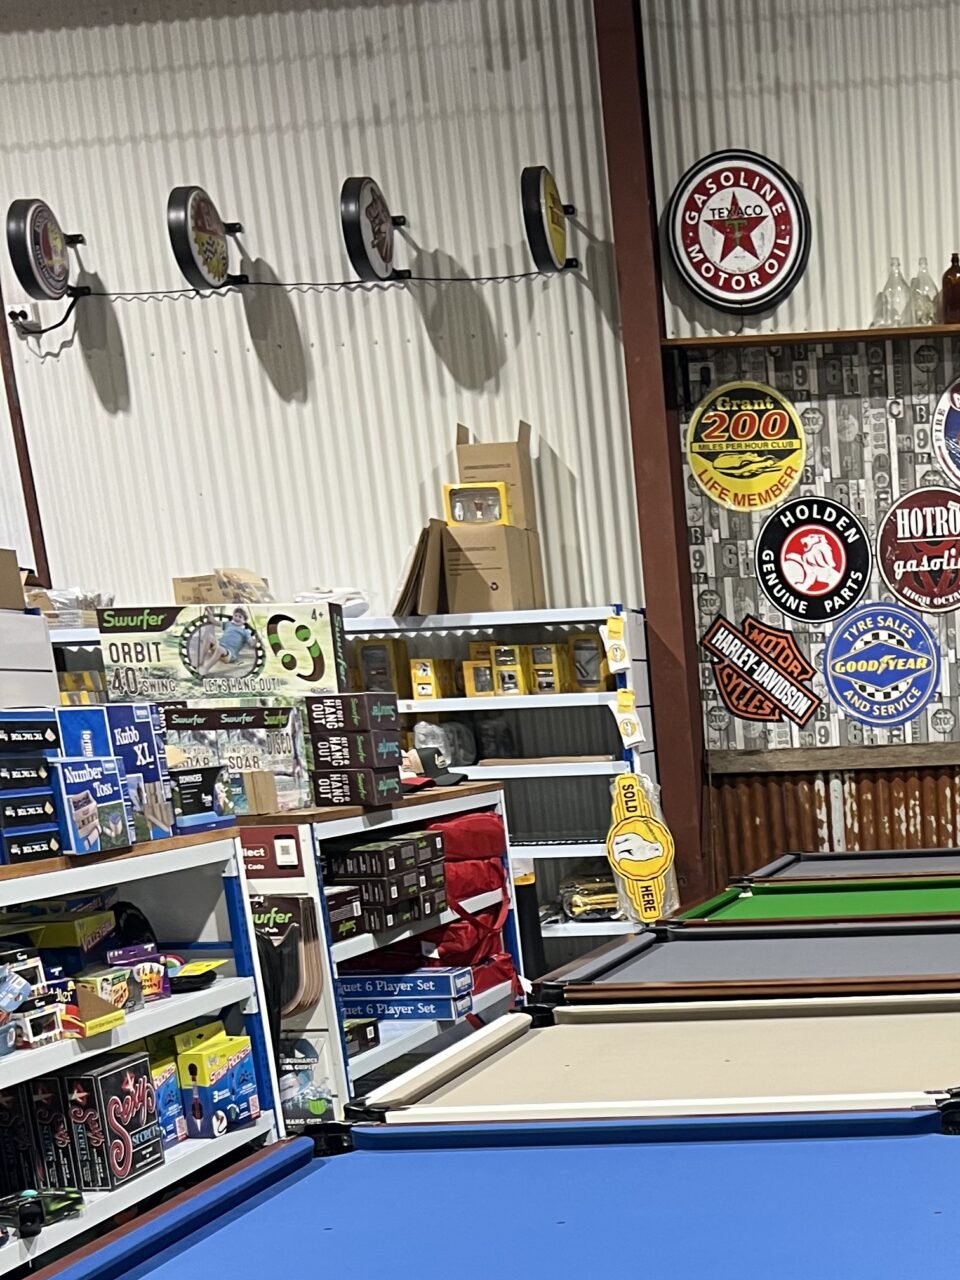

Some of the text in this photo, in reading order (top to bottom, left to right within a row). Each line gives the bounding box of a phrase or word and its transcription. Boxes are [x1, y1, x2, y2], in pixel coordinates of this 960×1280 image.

[685, 171, 786, 225] GASOLINE
[709, 204, 764, 219] TEXACO
[687, 235, 790, 291] MOTOR OIL
[715, 395, 775, 411] Grant
[700, 409, 790, 442] 200
[934, 407, 946, 442] FIRE
[698, 440, 794, 451] MILES PER HOUR CLUB
[697, 465, 799, 508] LIFE MEMBER
[779, 503, 861, 544] HOLDEN
[761, 549, 864, 614] GENUINE PARTS
[902, 586, 930, 606] HIGH
[102, 611, 166, 630] Swurfer
[310, 608, 324, 621] 4+
[842, 615, 916, 642] TYRE SALES
[108, 641, 162, 664] ORBIT
[749, 628, 803, 678] MOTOR
[711, 626, 813, 718] HARLEY-DAVIDSON
[834, 654, 928, 675] GOODYEAR
[141, 679, 177, 693] SWING
[203, 677, 281, 693] LET'S HANG OUT!
[721, 666, 775, 715] CYCLES
[843, 686, 923, 716] AND SERVICE
[171, 714, 208, 726] Swurfer
[220, 713, 256, 724] Swurfer
[311, 703, 326, 725] OUT
[323, 699, 338, 729] HANG
[336, 710, 344, 723] OUT
[114, 725, 140, 746] Kubb
[266, 732, 292, 755] DISCO
[340, 736, 348, 747] GET
[132, 743, 155, 765] XL
[228, 755, 260, 769] SOAR
[317, 741, 332, 763] OUT
[329, 736, 343, 767] HANG
[64, 763, 103, 784] Number
[93, 780, 113, 798] Toss
[318, 778, 332, 799] OUT
[329, 773, 344, 803] HANG
[342, 785, 350, 797] OUT
[621, 783, 638, 813] SOLD
[242, 847, 265, 857] llect
[640, 885, 656, 913] HERE
[252, 907, 293, 928] urfer
[365, 982, 373, 991] 6
[375, 979, 414, 995] Player
[416, 979, 436, 991] Set
[366, 1005, 374, 1014] 6
[376, 1003, 415, 1018] Player
[417, 1003, 437, 1013] Set
[213, 1090, 219, 1103] 3
[108, 1075, 157, 1179] Sexy
